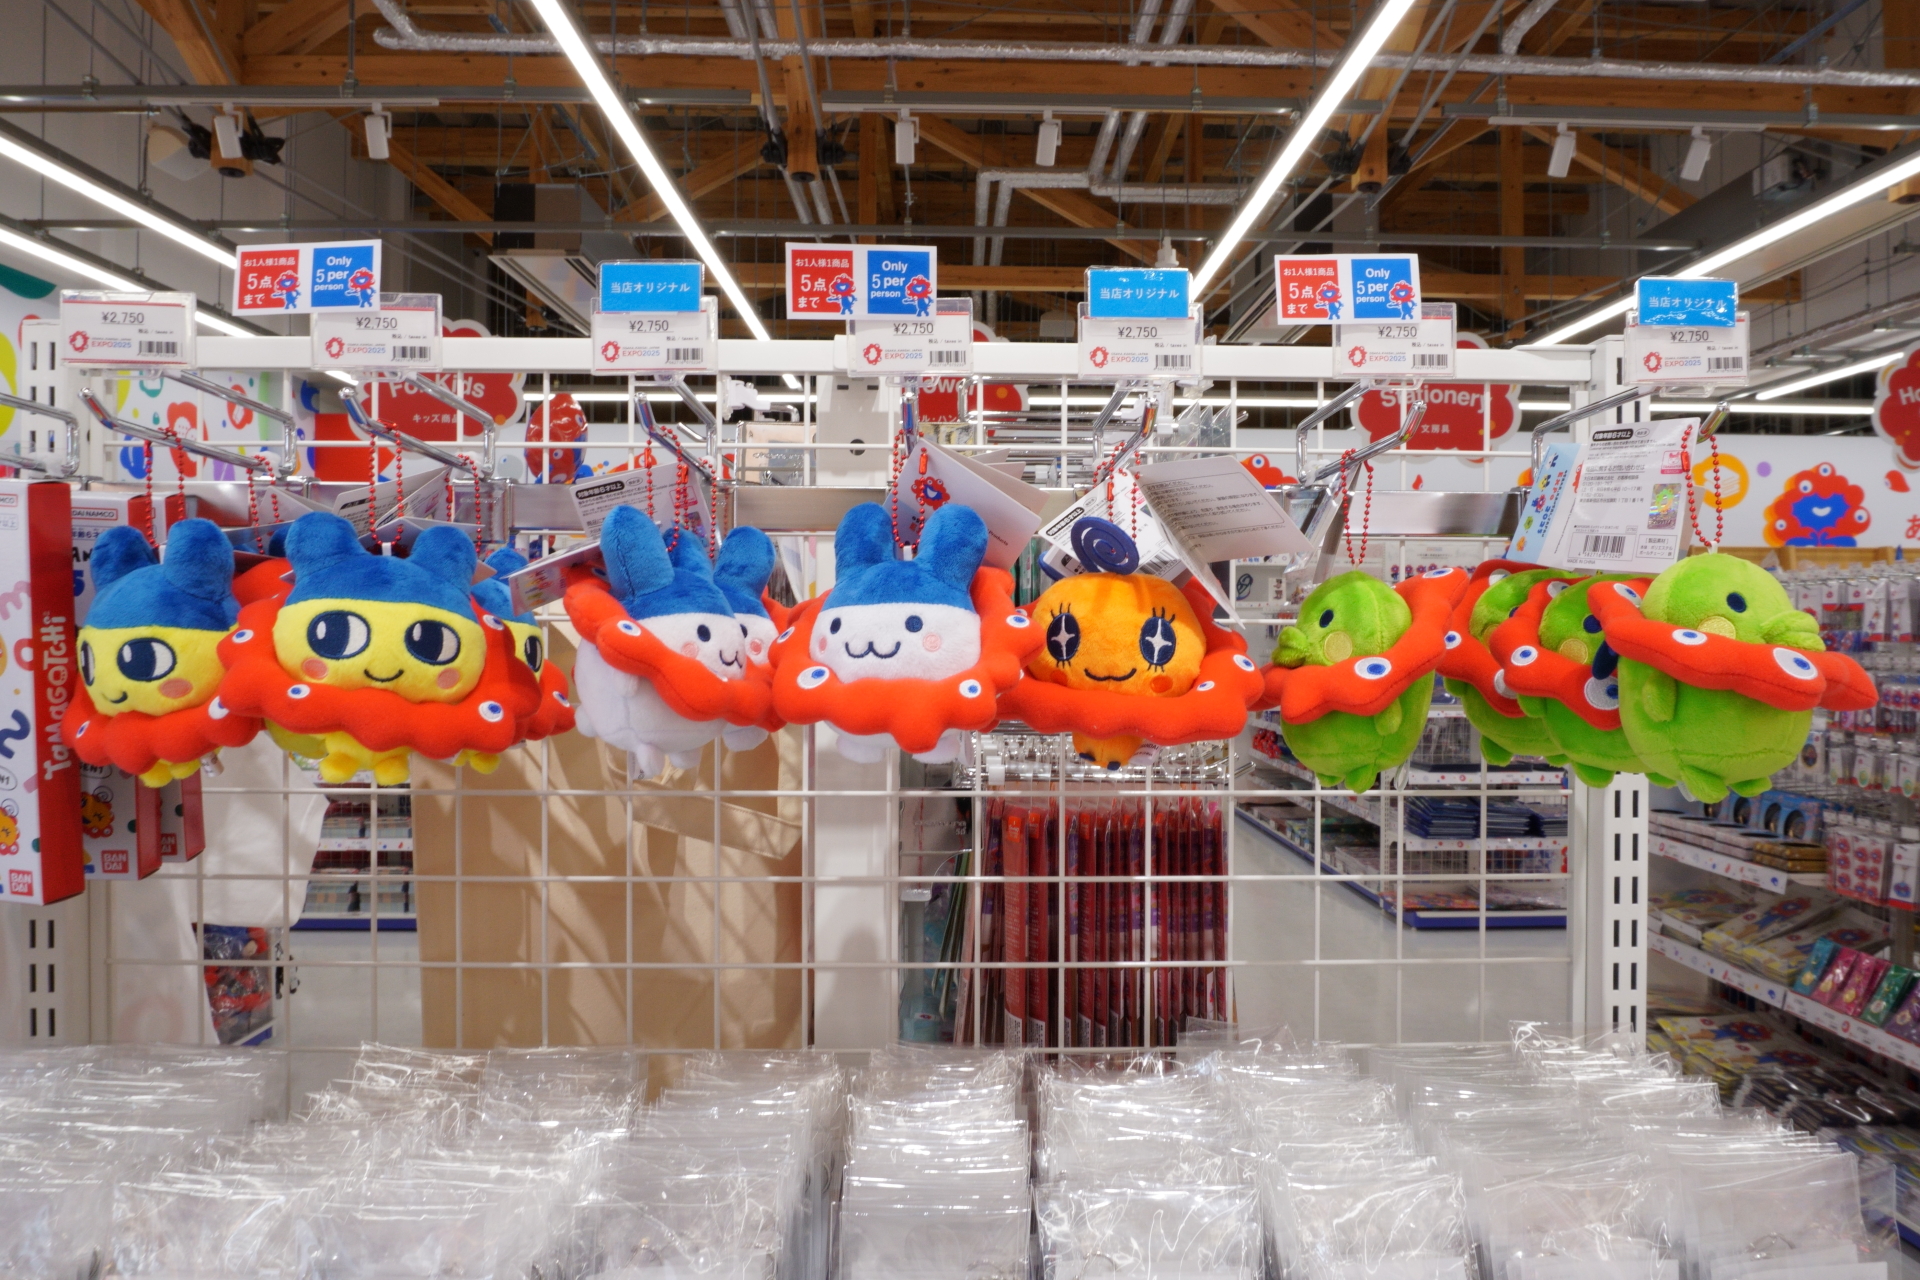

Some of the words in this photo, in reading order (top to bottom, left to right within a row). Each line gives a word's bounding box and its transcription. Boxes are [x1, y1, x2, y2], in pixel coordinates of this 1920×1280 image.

[244, 257, 295, 266] お1人様1商品
[327, 256, 352, 267] Only
[795, 258, 850, 268] お1人様1商品
[882, 261, 908, 273] Only
[316, 269, 325, 282] 5
[327, 270, 349, 281] per
[1283, 267, 1335, 276] お1人様1商品
[1365, 268, 1390, 279] Only
[247, 273, 272, 289] 5点
[801, 274, 827, 292] 5点
[872, 274, 880, 289] 5
[884, 277, 905, 288] per
[314, 283, 343, 292] person
[611, 282, 690, 293] 当店オリジナル
[1289, 283, 1314, 299] 5点
[1357, 281, 1365, 294] 5
[1368, 283, 1388, 294] per
[871, 290, 901, 299] person
[1100, 288, 1180, 299] 当店オリジナル
[244, 294, 265, 305] まで
[798, 297, 820, 308] まで
[1356, 295, 1385, 304] person
[1649, 297, 1727, 309] 当店オリジナル
[1287, 303, 1308, 314] まで
[101, 311, 145, 324] ¥2,750
[356, 317, 398, 329] ¥2,750
[629, 320, 669, 332] ¥2,750
[893, 322, 934, 335] ¥2,750
[1118, 327, 1158, 338] ¥2,750
[1378, 326, 1418, 338] ¥2,750
[1670, 330, 1709, 342] ¥2,750
[389, 378, 424, 398] Fo
[1421, 424, 1450, 434] 文房具
[103, 853, 126, 862] BAN
[104, 862, 122, 871] DAI
[11, 873, 32, 883] BAN
[12, 883, 29, 893] DAI
